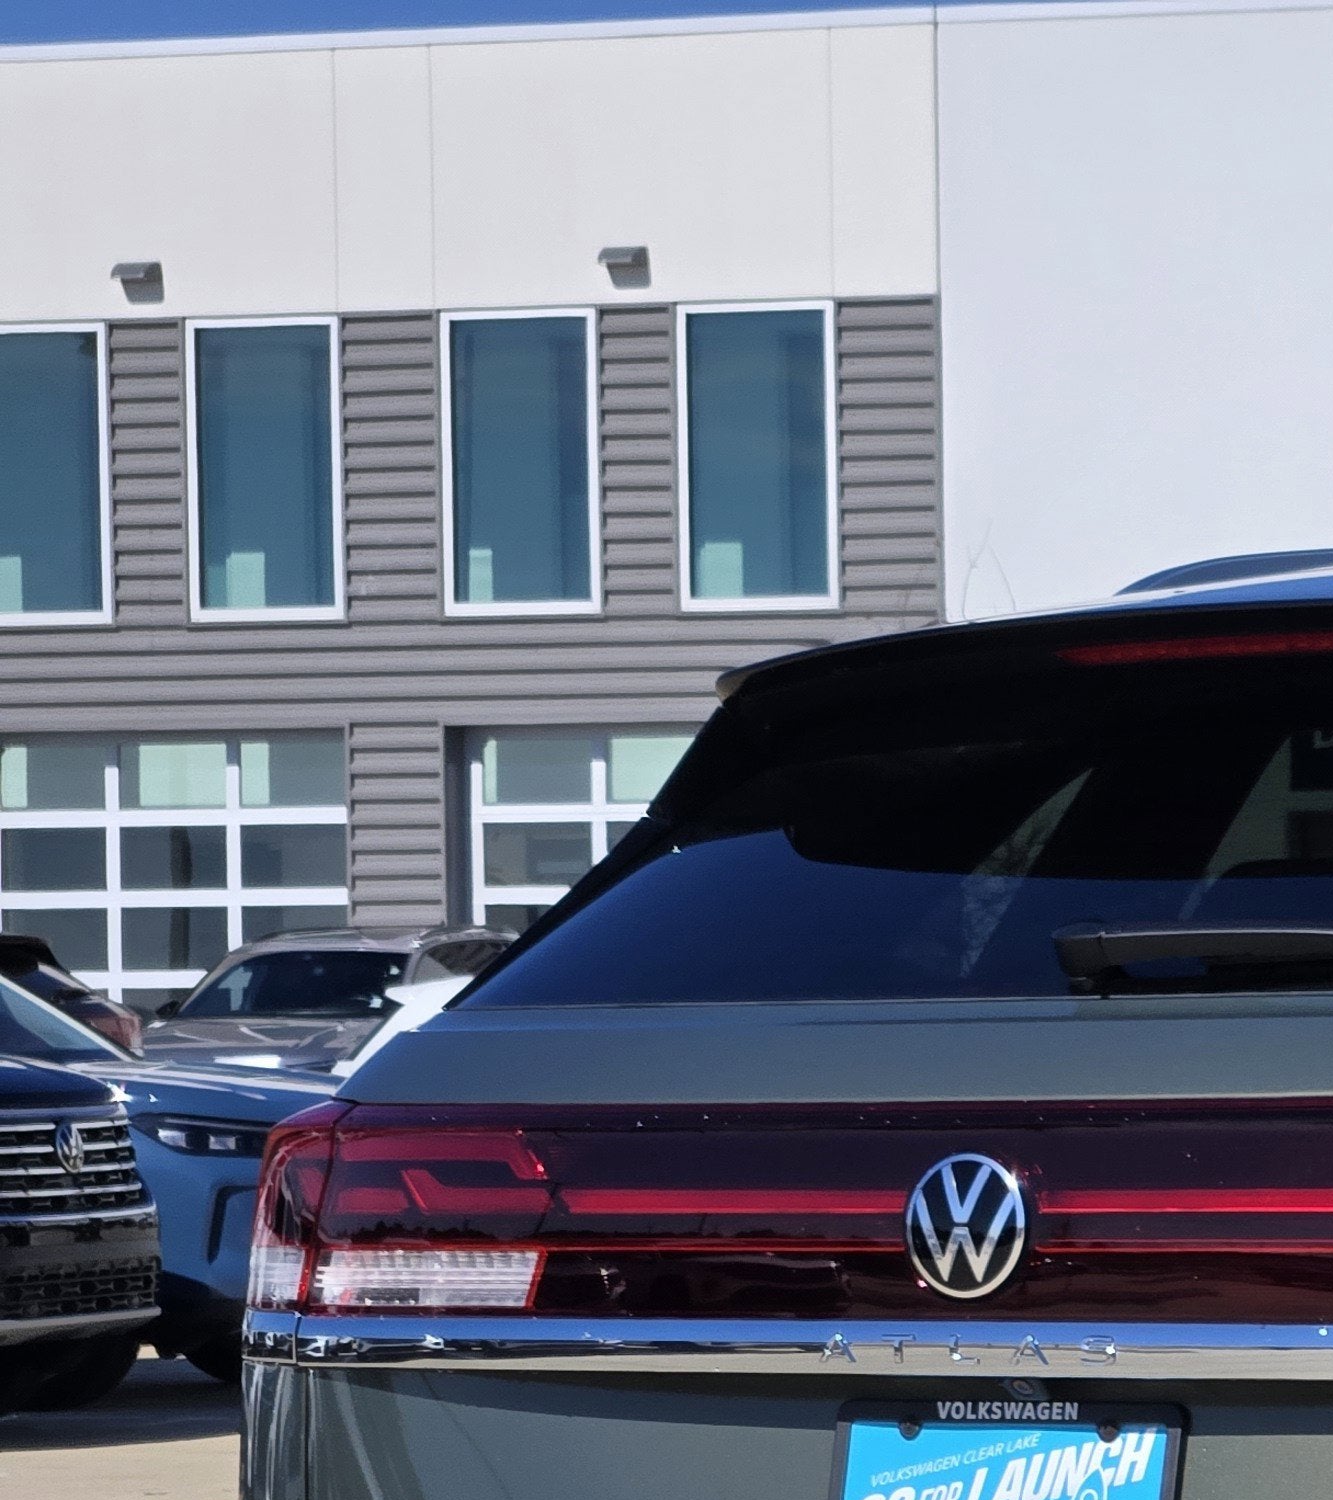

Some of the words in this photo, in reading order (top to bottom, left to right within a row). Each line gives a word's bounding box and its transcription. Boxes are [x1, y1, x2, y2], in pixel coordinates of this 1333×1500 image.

[818, 1332, 1118, 1366] ATLAS
[936, 1401, 1079, 1421] VOLKSWAGEN
[871, 1454, 960, 1488] VOLKSWAGEN
[963, 1442, 1003, 1465] CLEAR
[1005, 1432, 1042, 1453] LAKE
